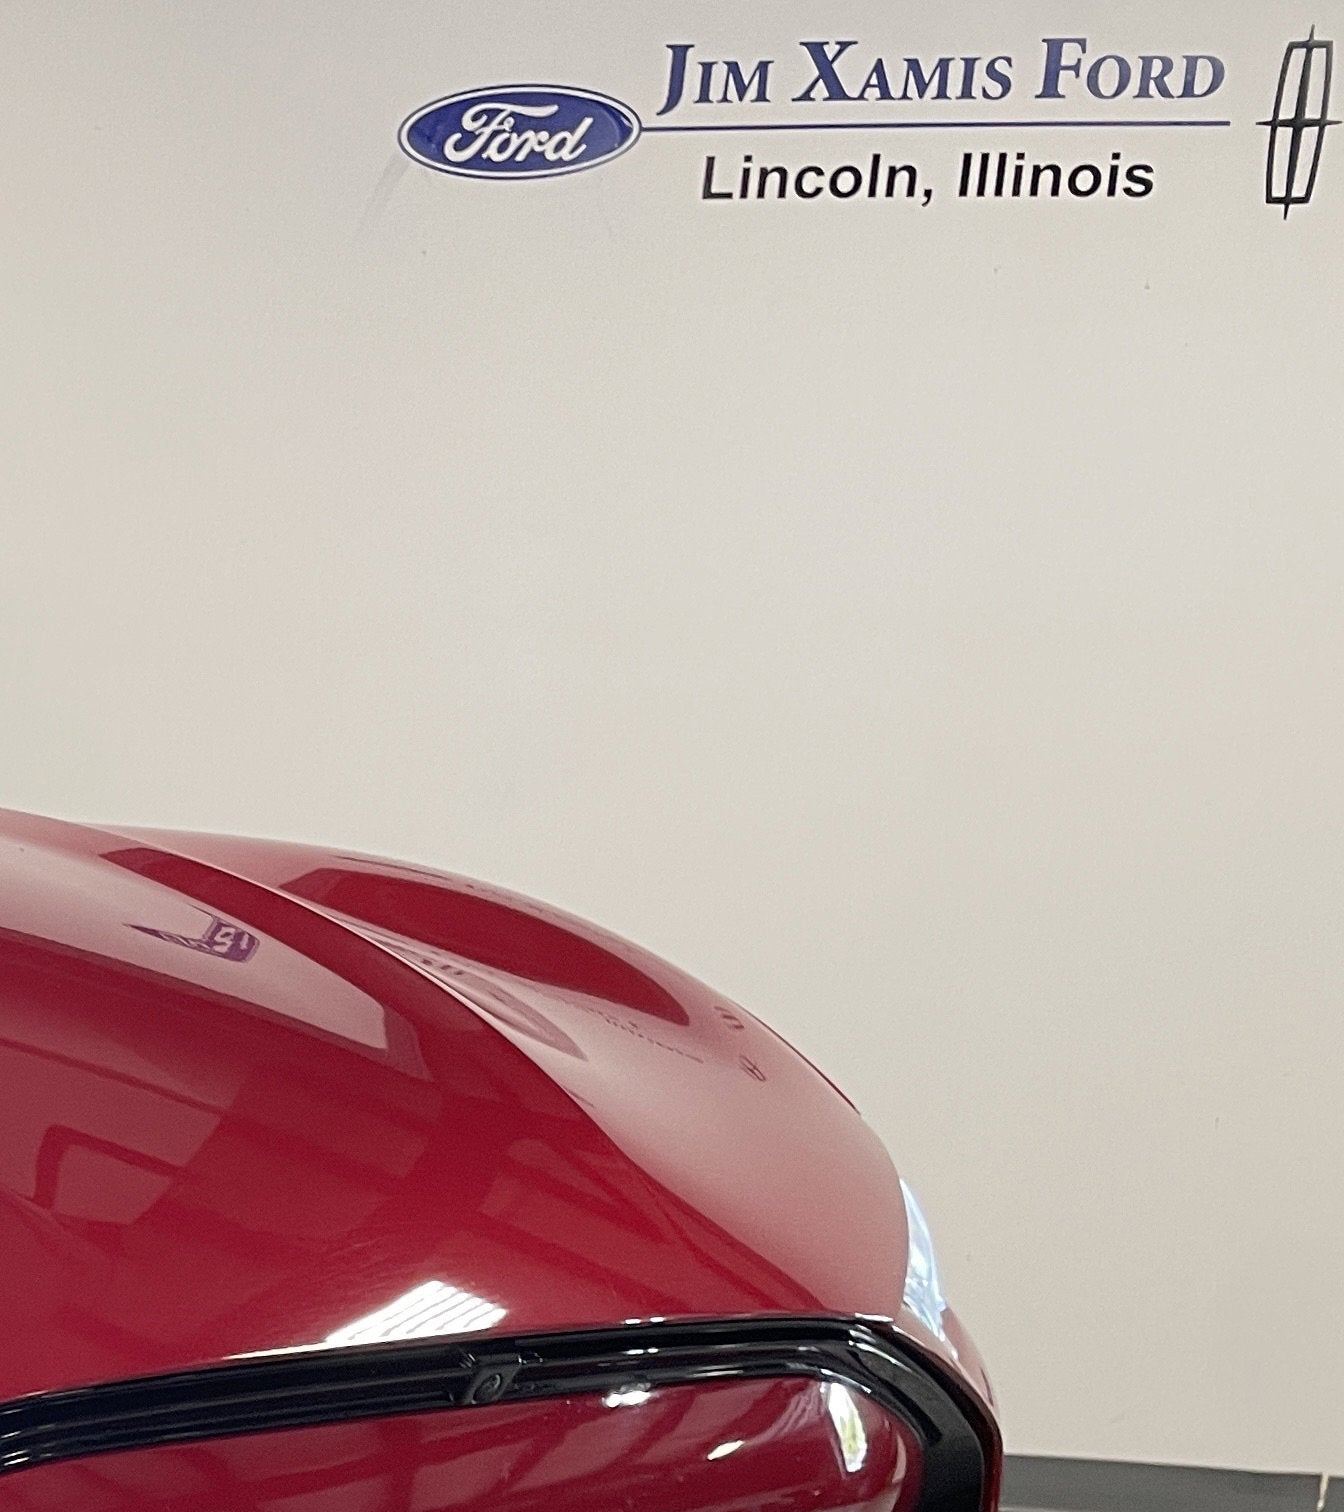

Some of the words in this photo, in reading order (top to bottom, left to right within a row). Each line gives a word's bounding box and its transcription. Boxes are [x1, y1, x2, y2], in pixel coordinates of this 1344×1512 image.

[442, 101, 592, 164] Ford
[701, 153, 934, 208] Lincoln,
[958, 151, 1155, 199] Illinois
